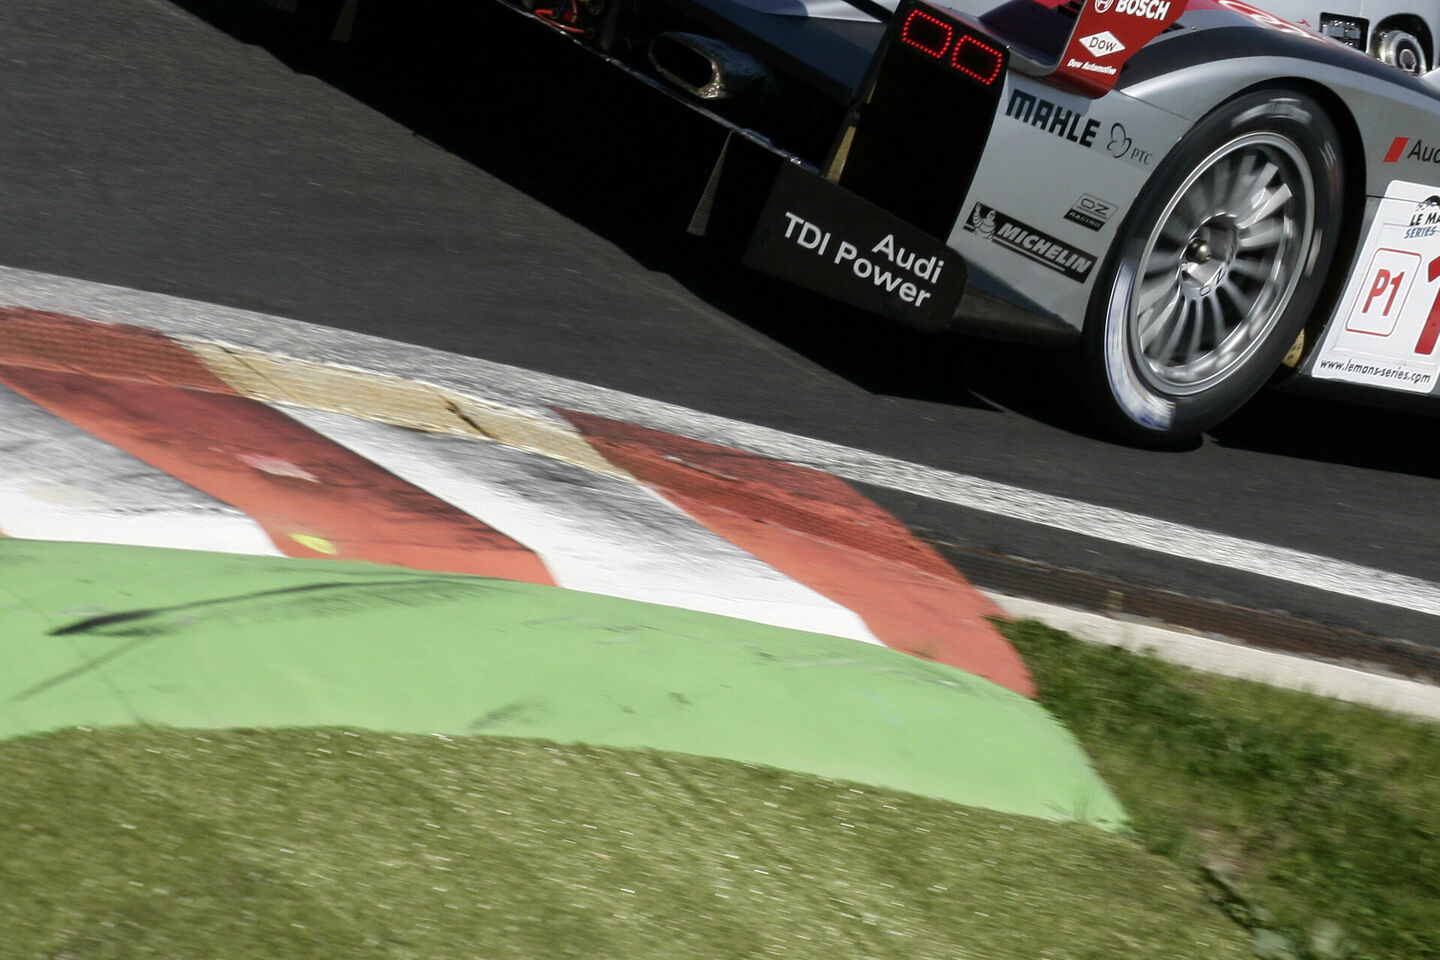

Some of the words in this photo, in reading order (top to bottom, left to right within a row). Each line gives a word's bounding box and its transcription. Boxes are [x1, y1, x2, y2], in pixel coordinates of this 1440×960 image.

[1005, 88, 1101, 148] MAHLE
[1130, 147, 1153, 166] PTC
[1081, 198, 1109, 216] OZ
[1409, 213, 1423, 226] LE
[997, 223, 1092, 273] MICHELIN
[1404, 226, 1437, 239] SERIES
[784, 211, 831, 256] TDI
[834, 242, 931, 308] Power
[872, 234, 945, 284] Audi
[1362, 269, 1405, 317] P1
[1320, 359, 1431, 382] www.lemans-series.com
